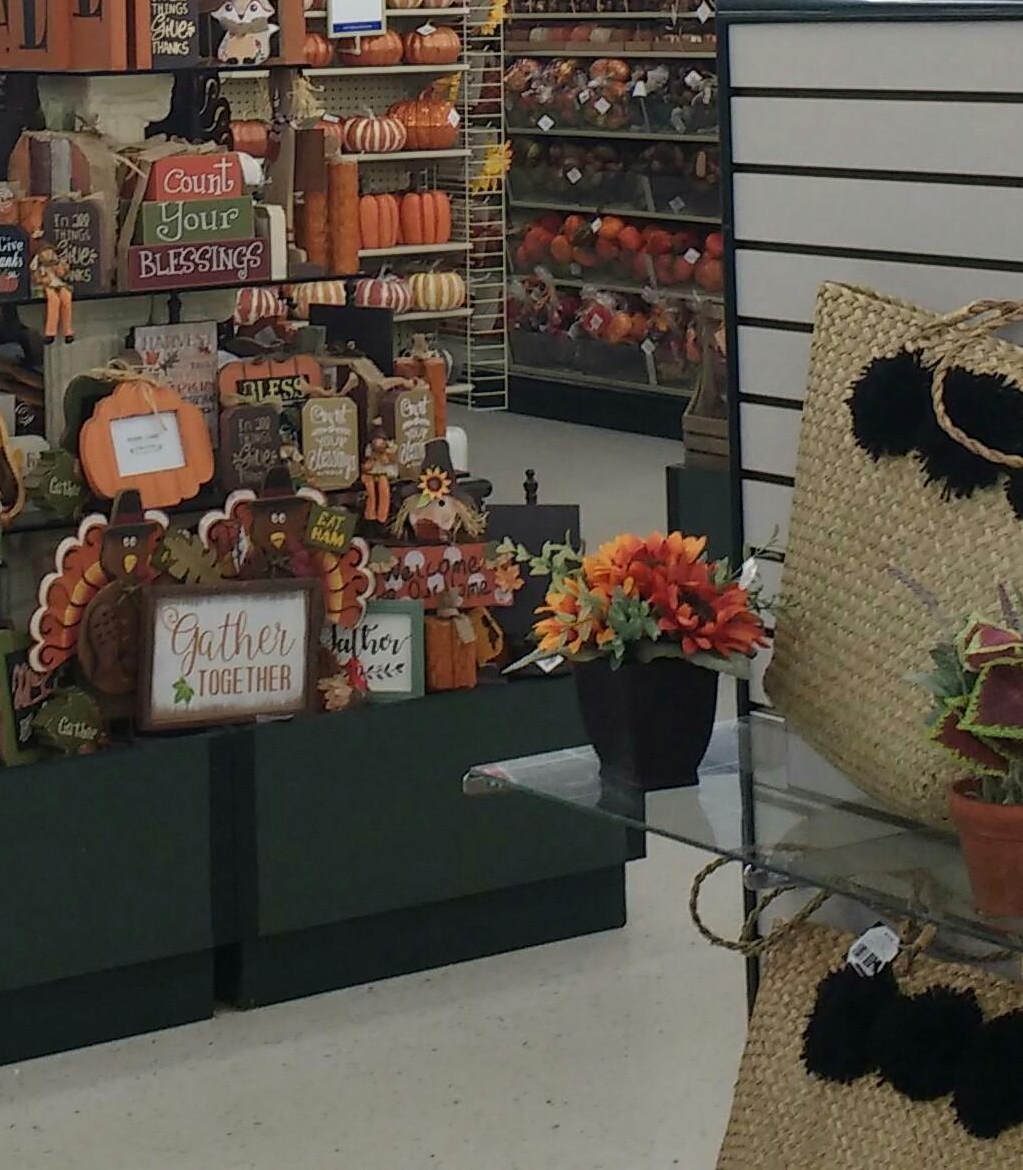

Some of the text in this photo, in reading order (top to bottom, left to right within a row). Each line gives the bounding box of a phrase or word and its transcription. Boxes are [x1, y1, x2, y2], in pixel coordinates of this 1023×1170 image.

[152, 3, 189, 15] THINGS
[151, 13, 191, 41] Give
[152, 41, 190, 55] THANKS
[164, 156, 235, 196] Count
[156, 201, 240, 242] Your
[139, 240, 264, 280] BLESSINGS
[242, 378, 307, 404] BLESS
[317, 511, 347, 530] EAT
[310, 526, 347, 548] HAM
[161, 606, 297, 677] Gather
[198, 664, 292, 698] TOGETHER
